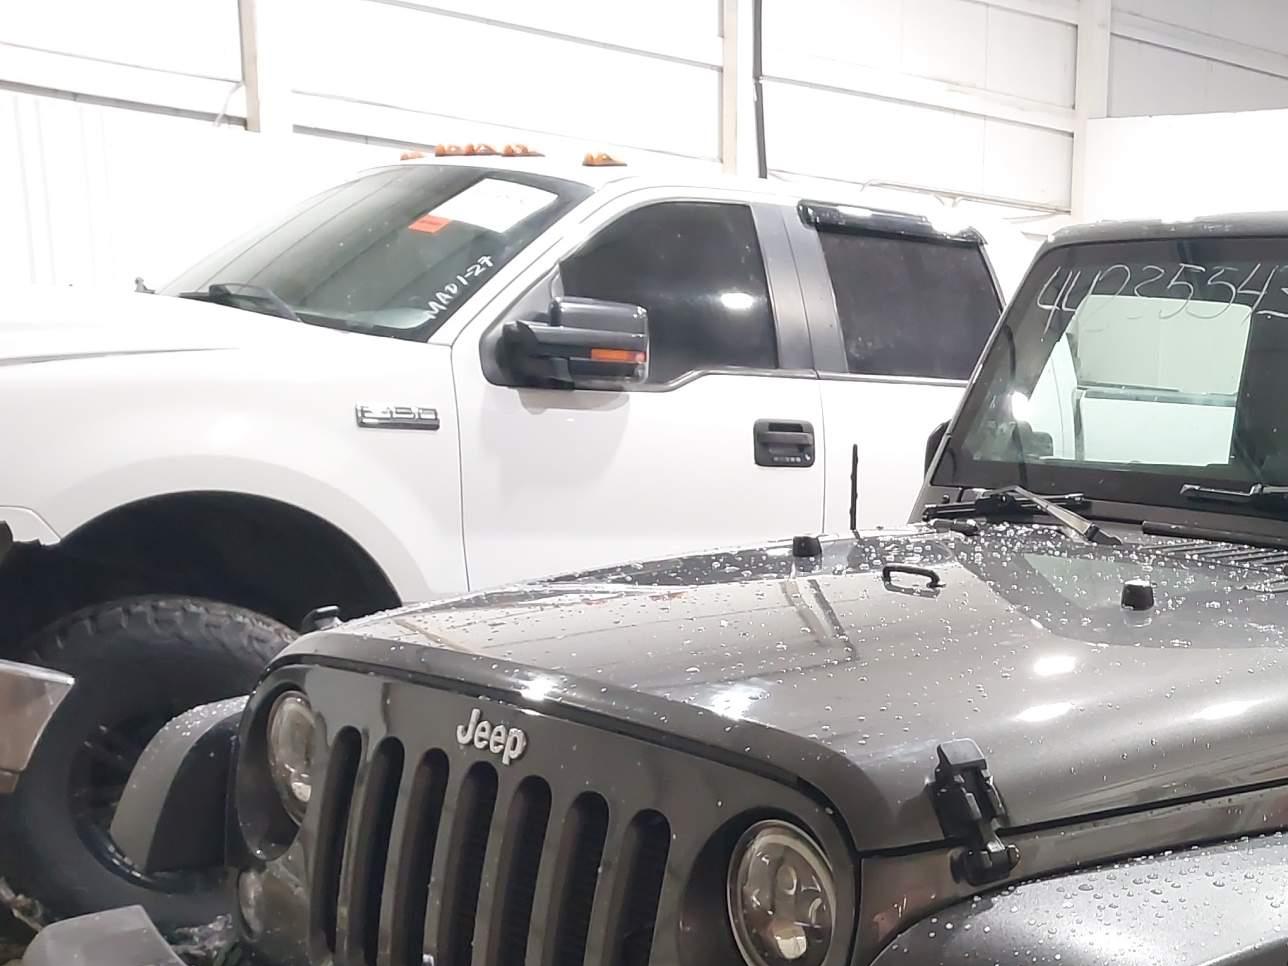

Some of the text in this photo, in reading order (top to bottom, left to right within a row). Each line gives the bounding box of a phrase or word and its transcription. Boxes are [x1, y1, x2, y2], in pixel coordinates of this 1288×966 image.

[423, 255, 494, 320] MAD 1-27
[456, 708, 527, 766] Jeep
